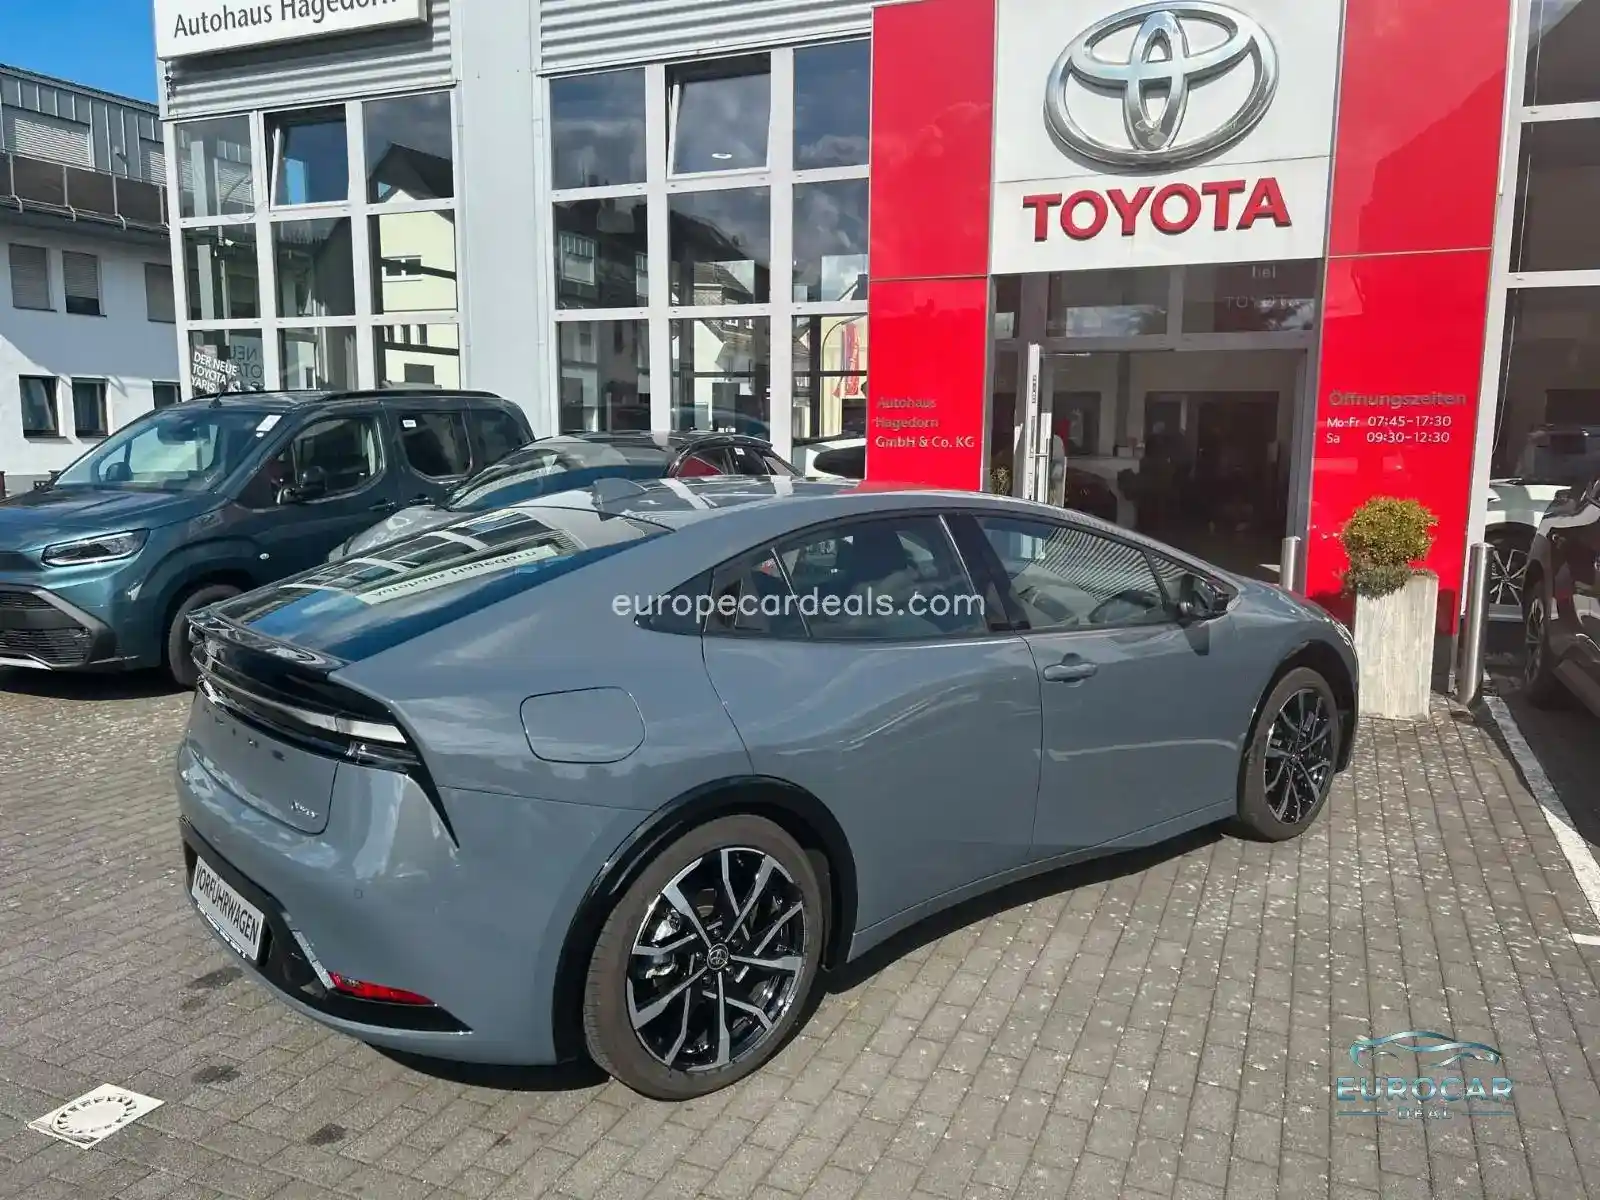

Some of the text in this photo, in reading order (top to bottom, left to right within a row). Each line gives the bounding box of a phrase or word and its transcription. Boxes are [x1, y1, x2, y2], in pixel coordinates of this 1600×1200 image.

[173, 0, 397, 39] Autohaus Hagedo
[1022, 177, 1292, 242] TOYOTA
[194, 352, 237, 376] DER NEUE
[192, 363, 227, 386] TOYOTA
[191, 376, 216, 393] YARIS
[876, 396, 937, 409] Autohaus
[1329, 389, 1467, 409] Öffnungszeiten
[875, 417, 938, 431] Hagedorn
[1327, 415, 1452, 428] Mo-Fr 07:45-17:30
[875, 435, 975, 448] GmbH & Co. KG
[1326, 431, 1450, 444] Sa 09:30-12:30
[195, 864, 260, 946] VORFÜHRWAGEN
